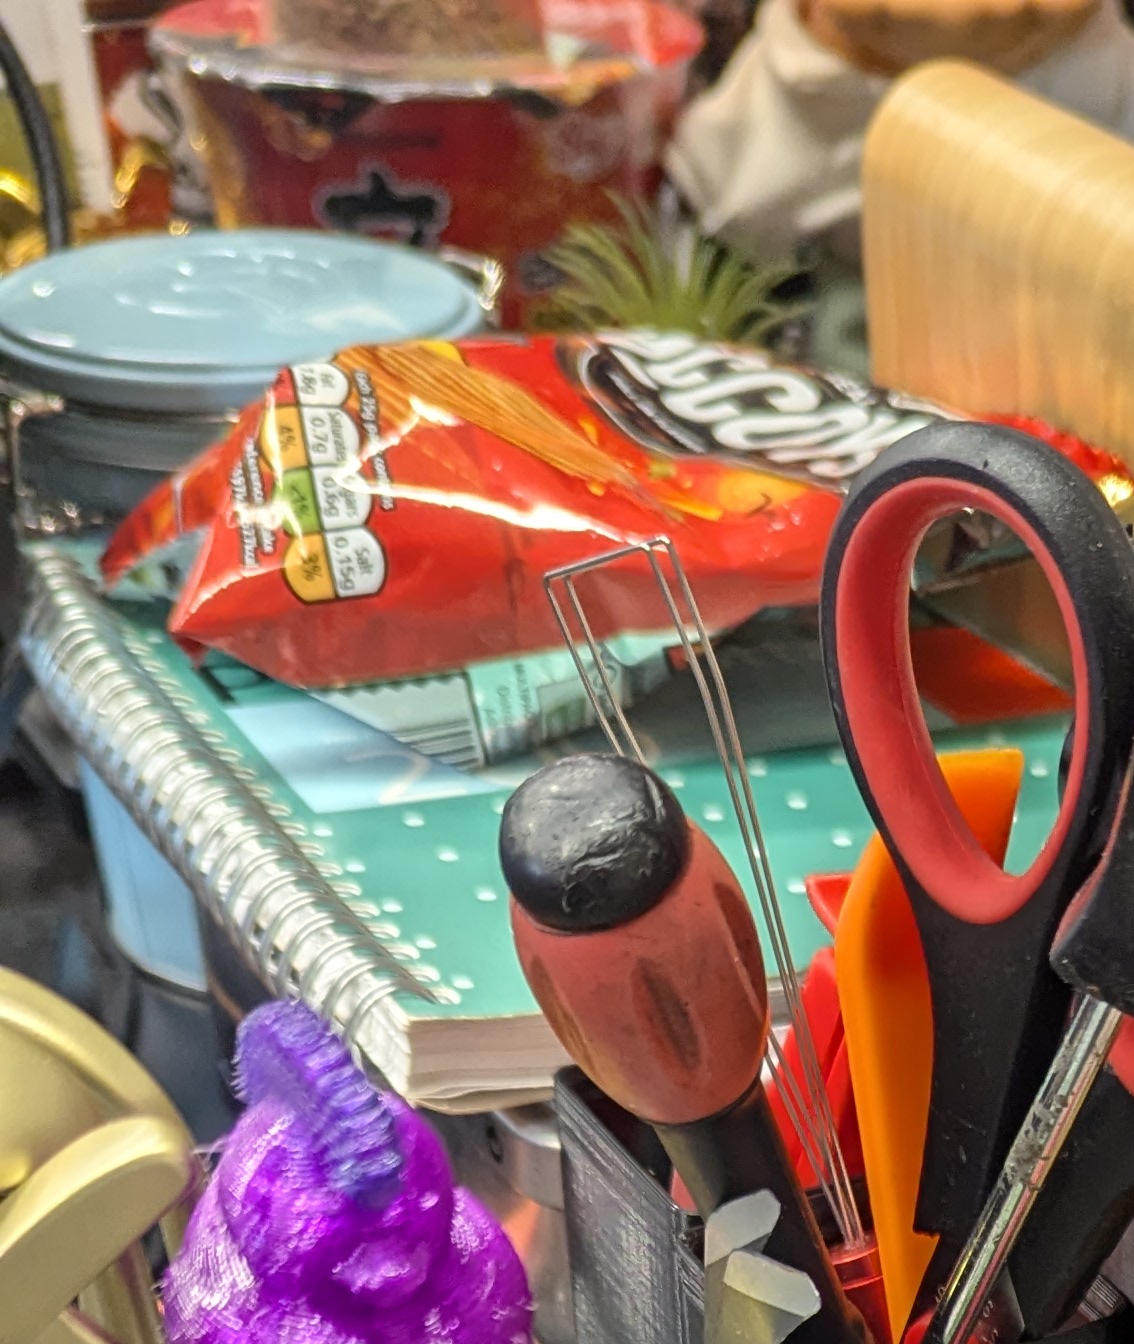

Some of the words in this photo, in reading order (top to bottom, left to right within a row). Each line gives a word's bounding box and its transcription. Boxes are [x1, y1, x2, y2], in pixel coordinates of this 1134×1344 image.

[310, 415, 328, 455] 0.7g
[322, 476, 340, 519] 0.6g
[333, 536, 356, 592] 0.15g
[353, 544, 374, 577] Salt
